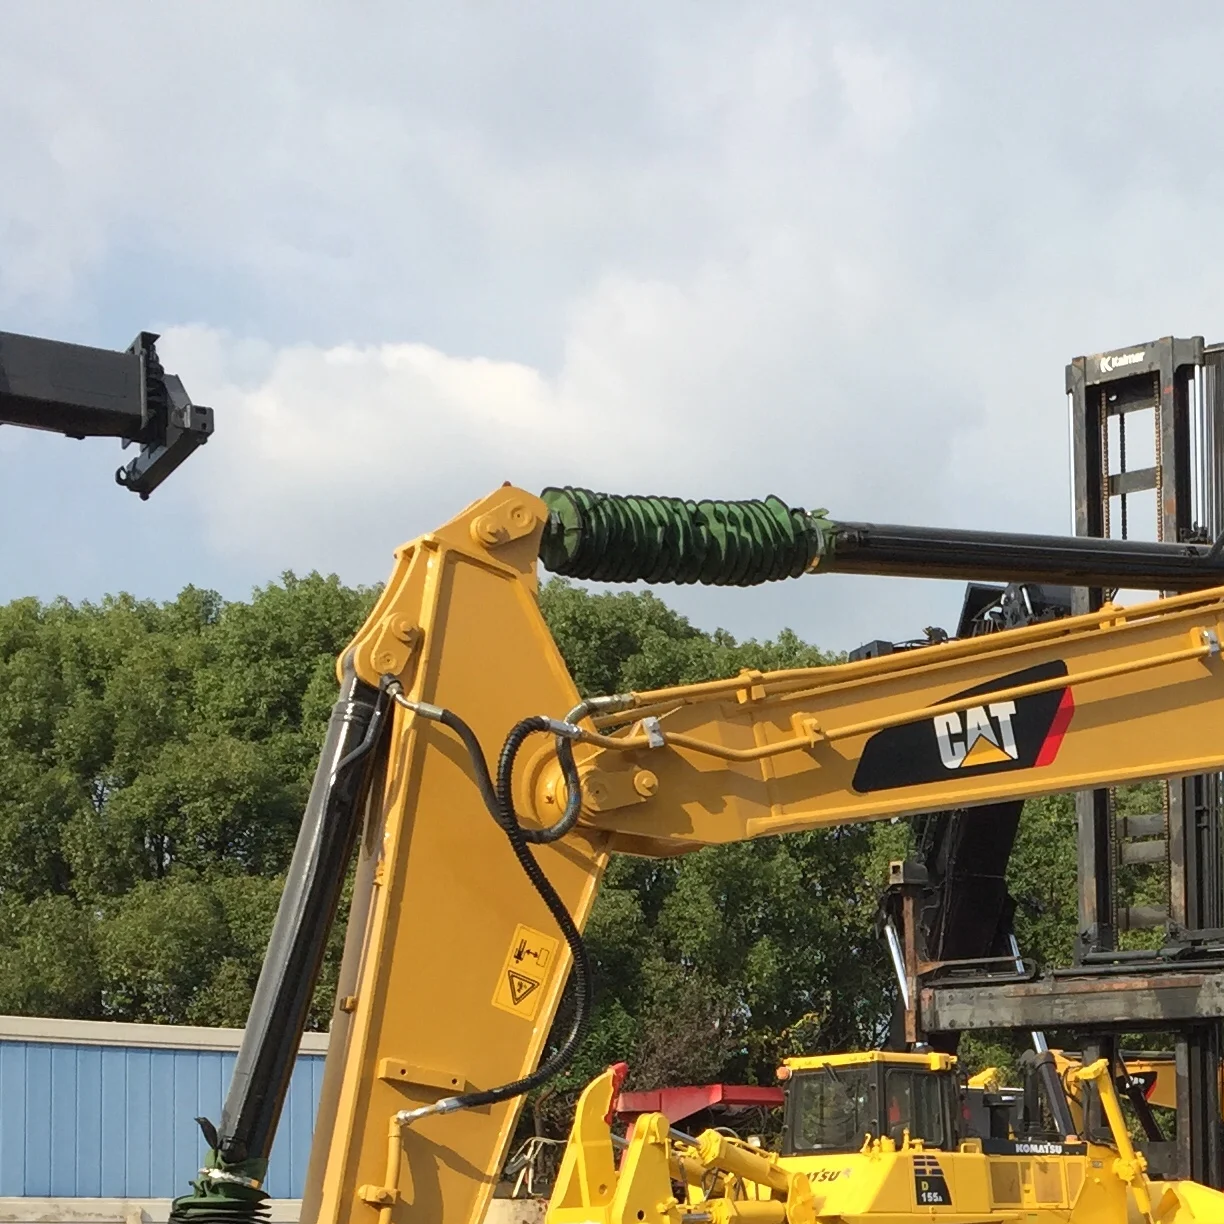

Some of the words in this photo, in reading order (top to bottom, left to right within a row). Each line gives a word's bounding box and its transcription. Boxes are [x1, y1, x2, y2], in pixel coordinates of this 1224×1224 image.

[933, 700, 1019, 769] CAT
[1015, 1141, 1063, 1154] KOMATSU
[921, 1180, 929, 1191] D
